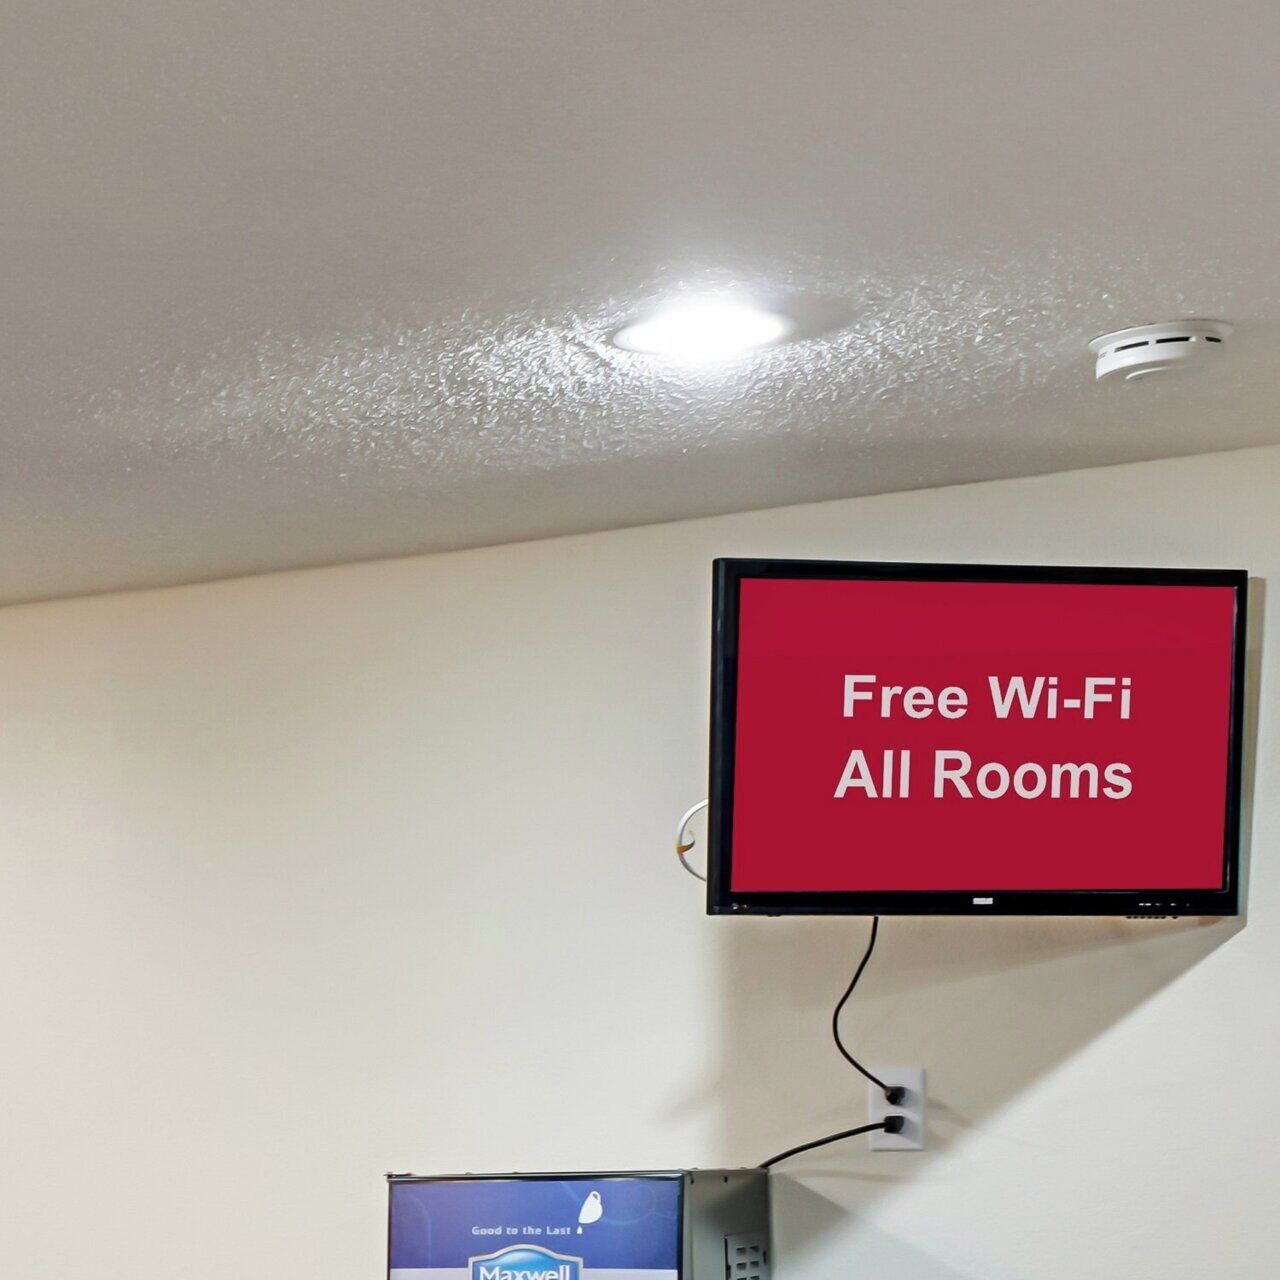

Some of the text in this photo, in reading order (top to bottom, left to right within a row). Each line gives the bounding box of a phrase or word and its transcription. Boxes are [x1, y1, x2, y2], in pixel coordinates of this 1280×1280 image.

[843, 674, 1132, 720] Free Wi-Fi
[833, 749, 1133, 800] All Rooms
[471, 1226, 571, 1235] Good to the Last
